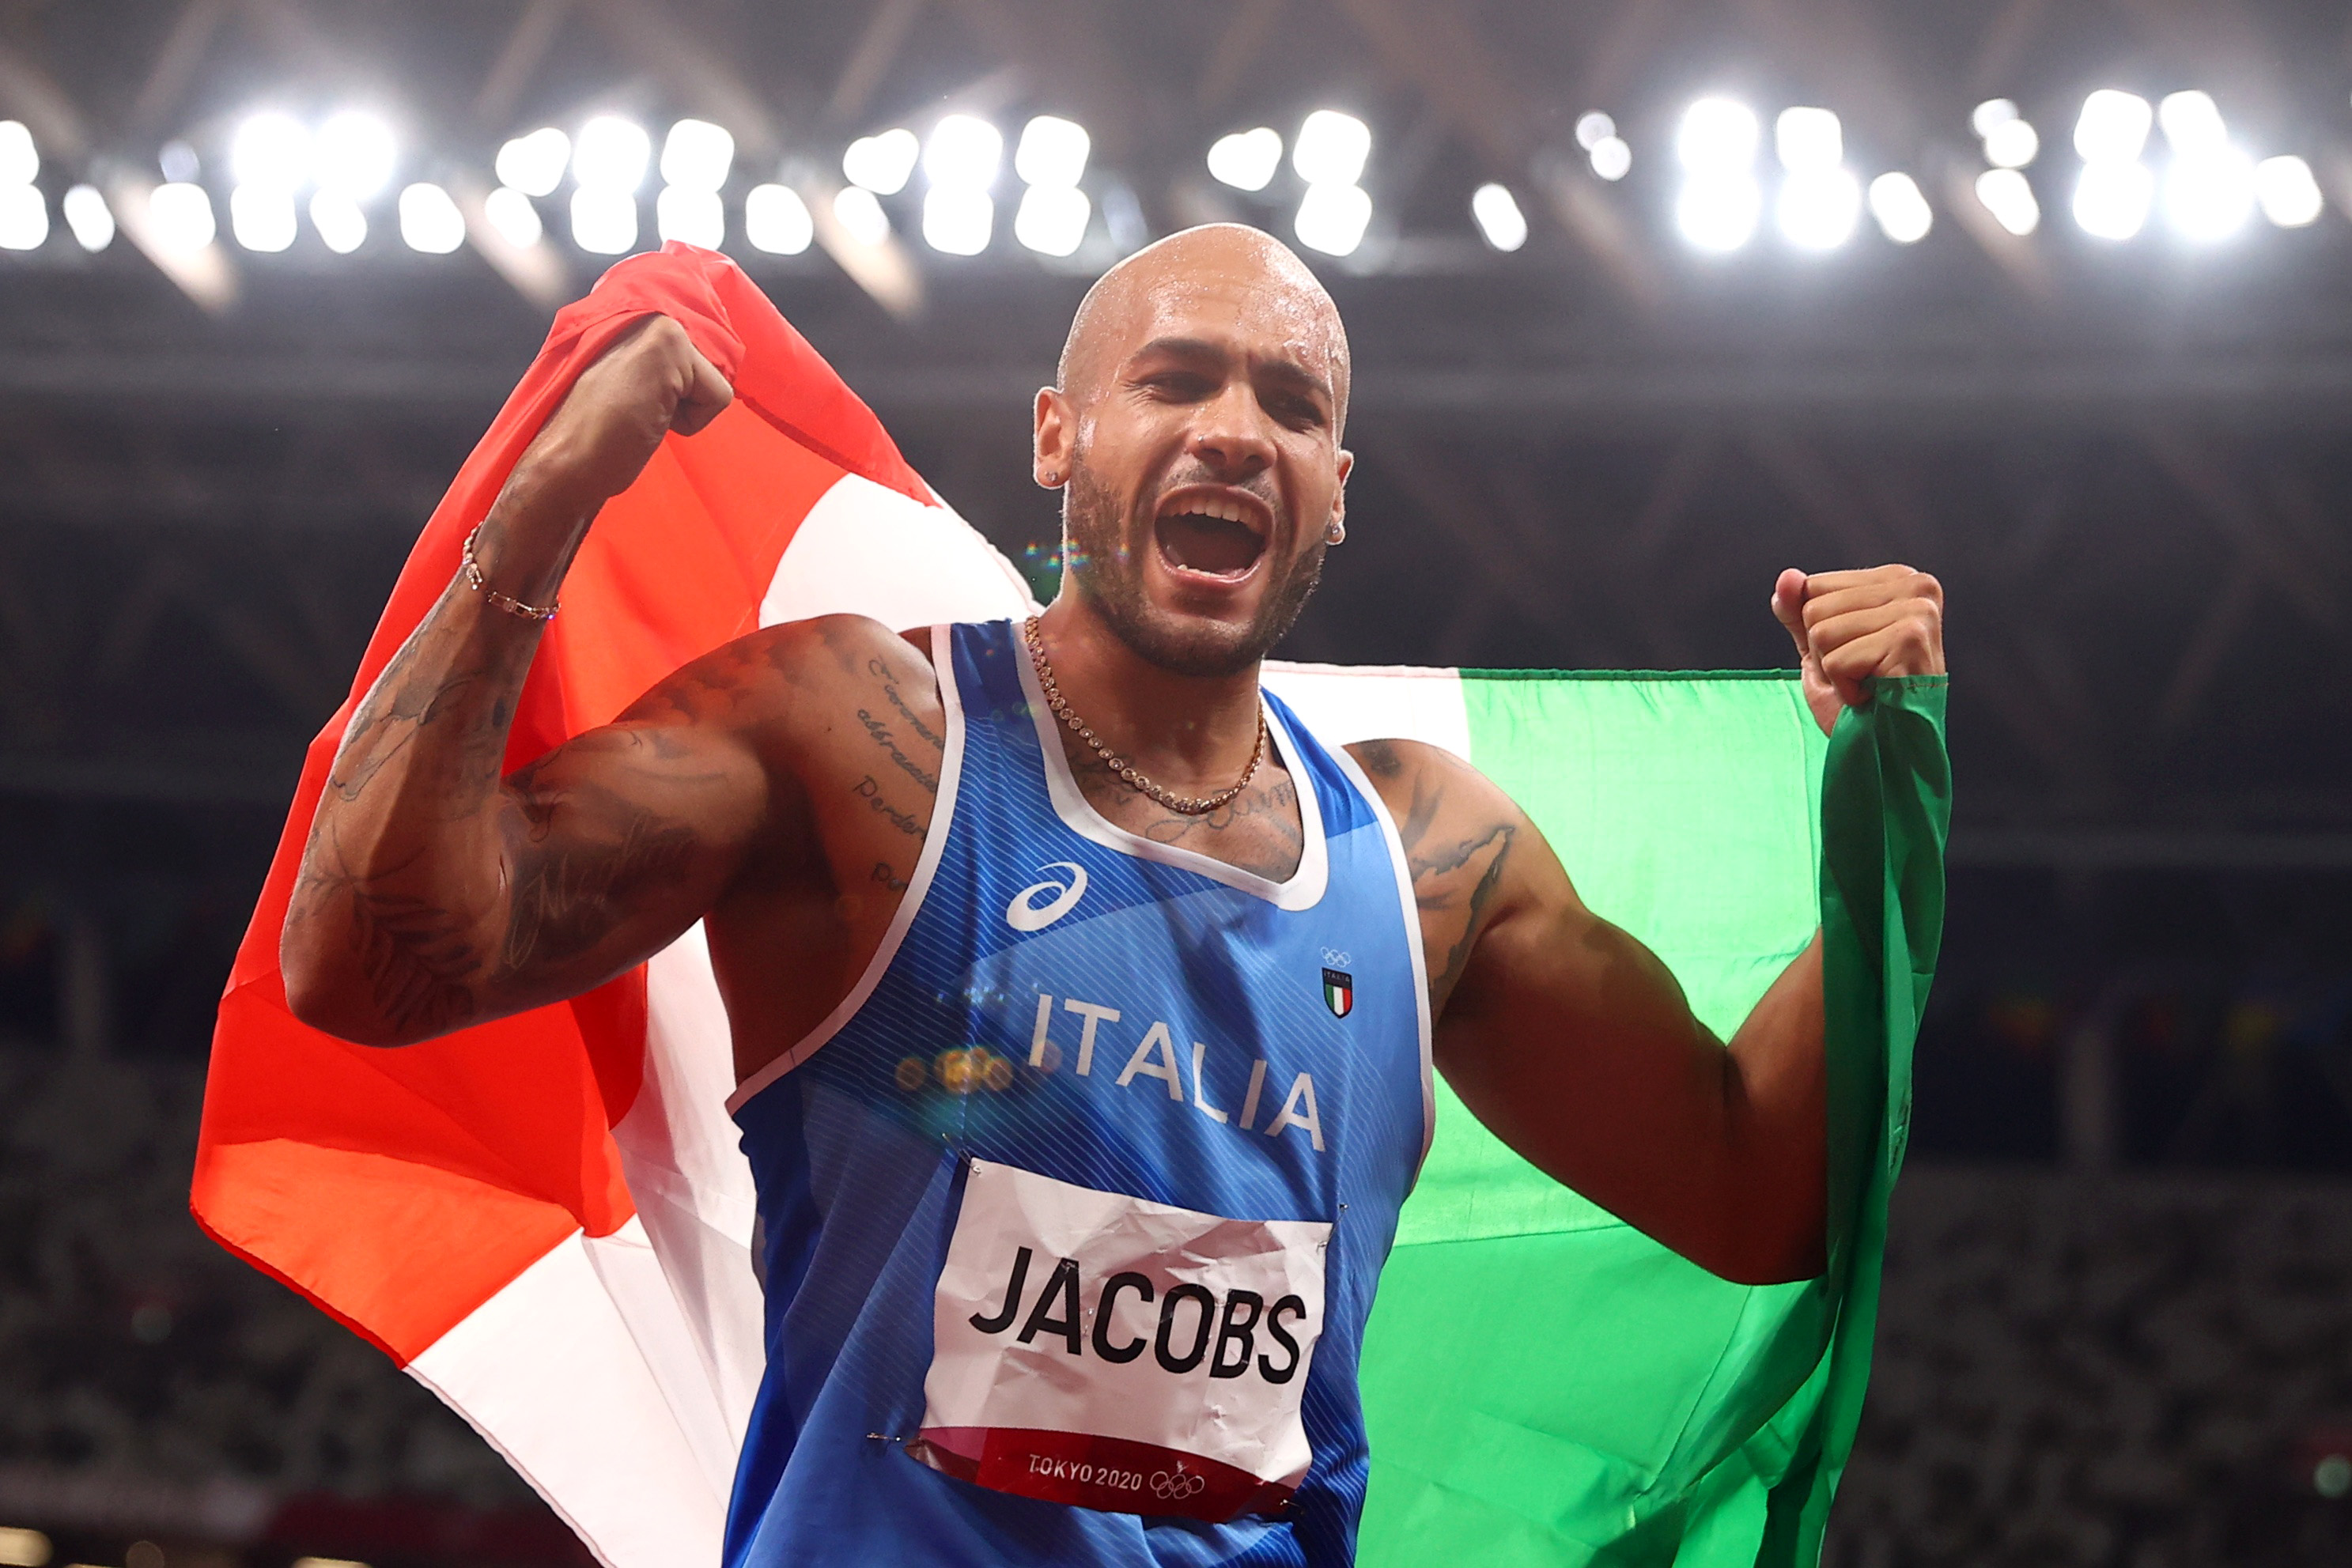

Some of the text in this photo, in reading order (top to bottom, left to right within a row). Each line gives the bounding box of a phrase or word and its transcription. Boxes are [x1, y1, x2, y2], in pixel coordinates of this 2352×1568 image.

[1324, 970, 1351, 983] ITALIA
[1028, 993, 1326, 1153] ITALIA
[969, 1245, 1307, 1385] JACOBS
[1028, 1453, 1143, 1491] TOKYO 2020
